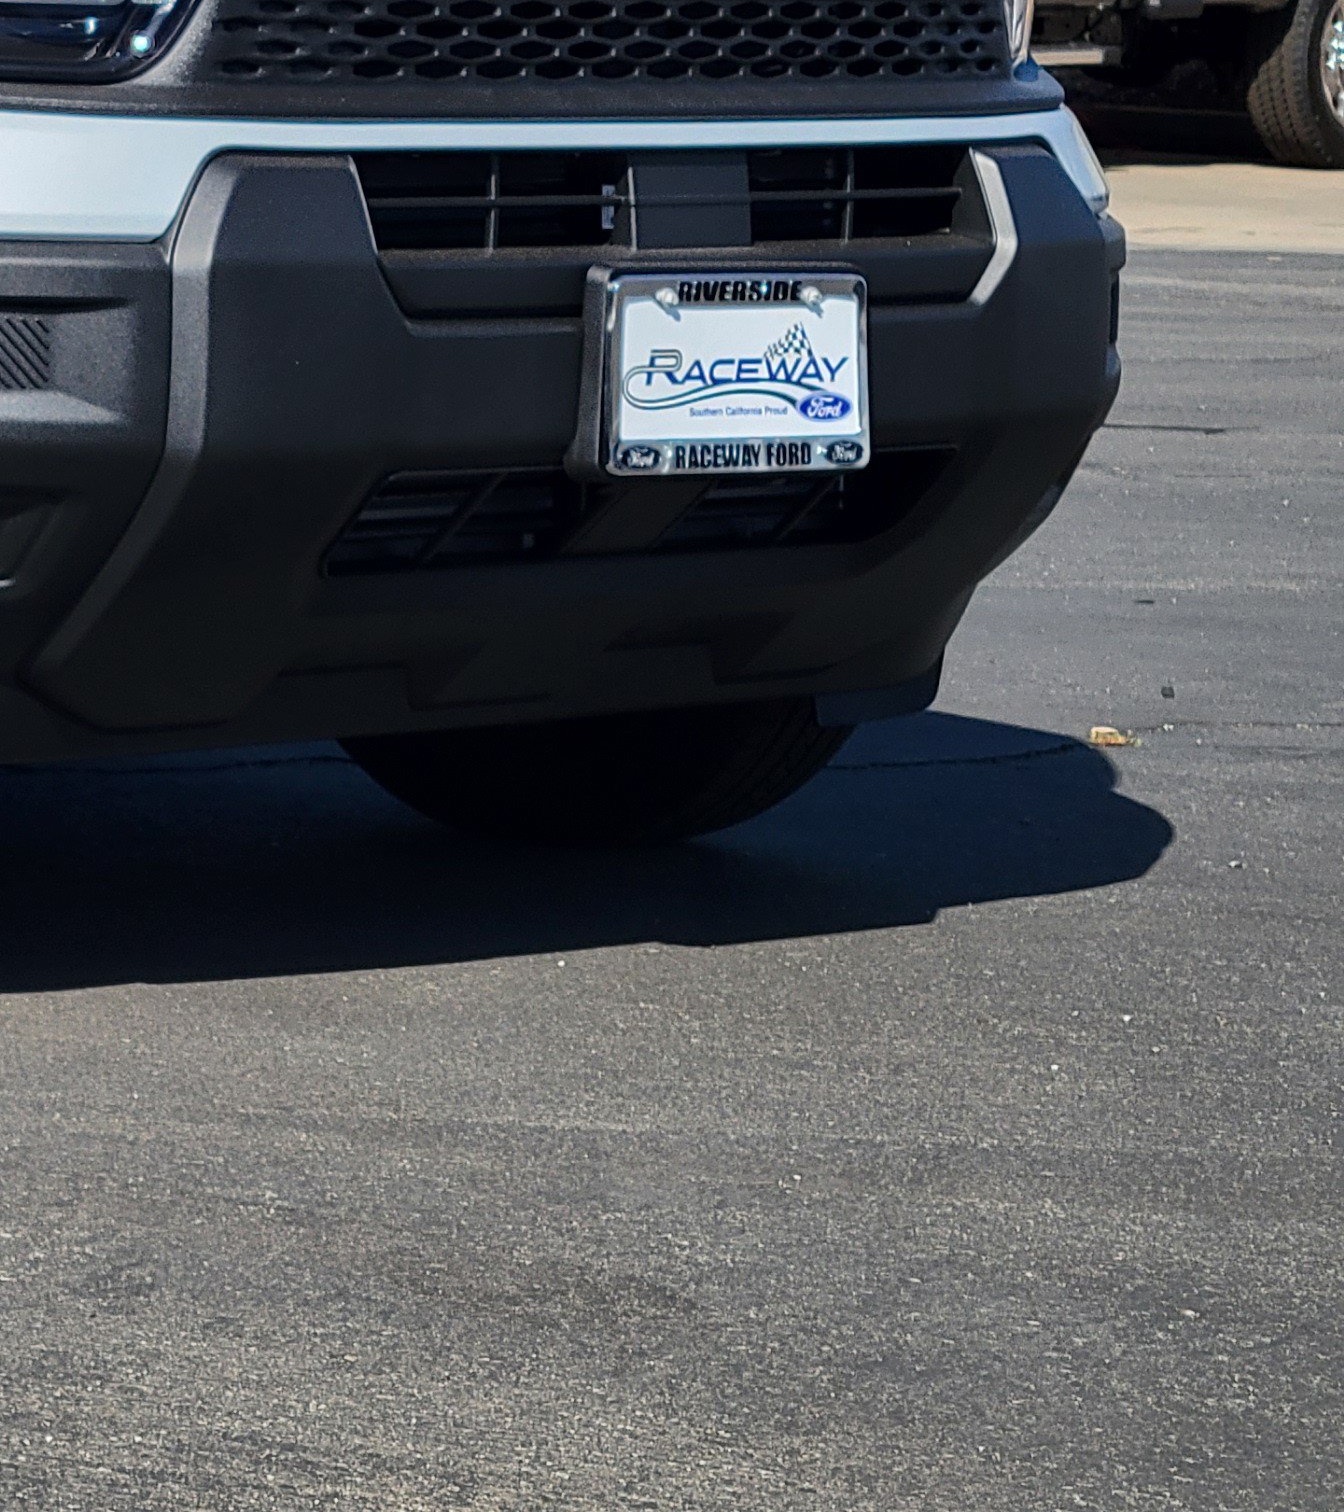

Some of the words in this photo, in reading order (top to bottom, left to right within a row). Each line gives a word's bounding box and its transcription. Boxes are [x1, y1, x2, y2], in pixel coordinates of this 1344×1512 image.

[678, 280, 803, 303] RIVERSIDE
[643, 349, 849, 387] RACEWAY
[689, 407, 724, 417] Southern
[725, 406, 763, 417] California
[764, 405, 788, 416] Proud
[806, 396, 844, 419] Ford
[675, 443, 761, 469] RACEWAY
[766, 442, 812, 467] FORD
